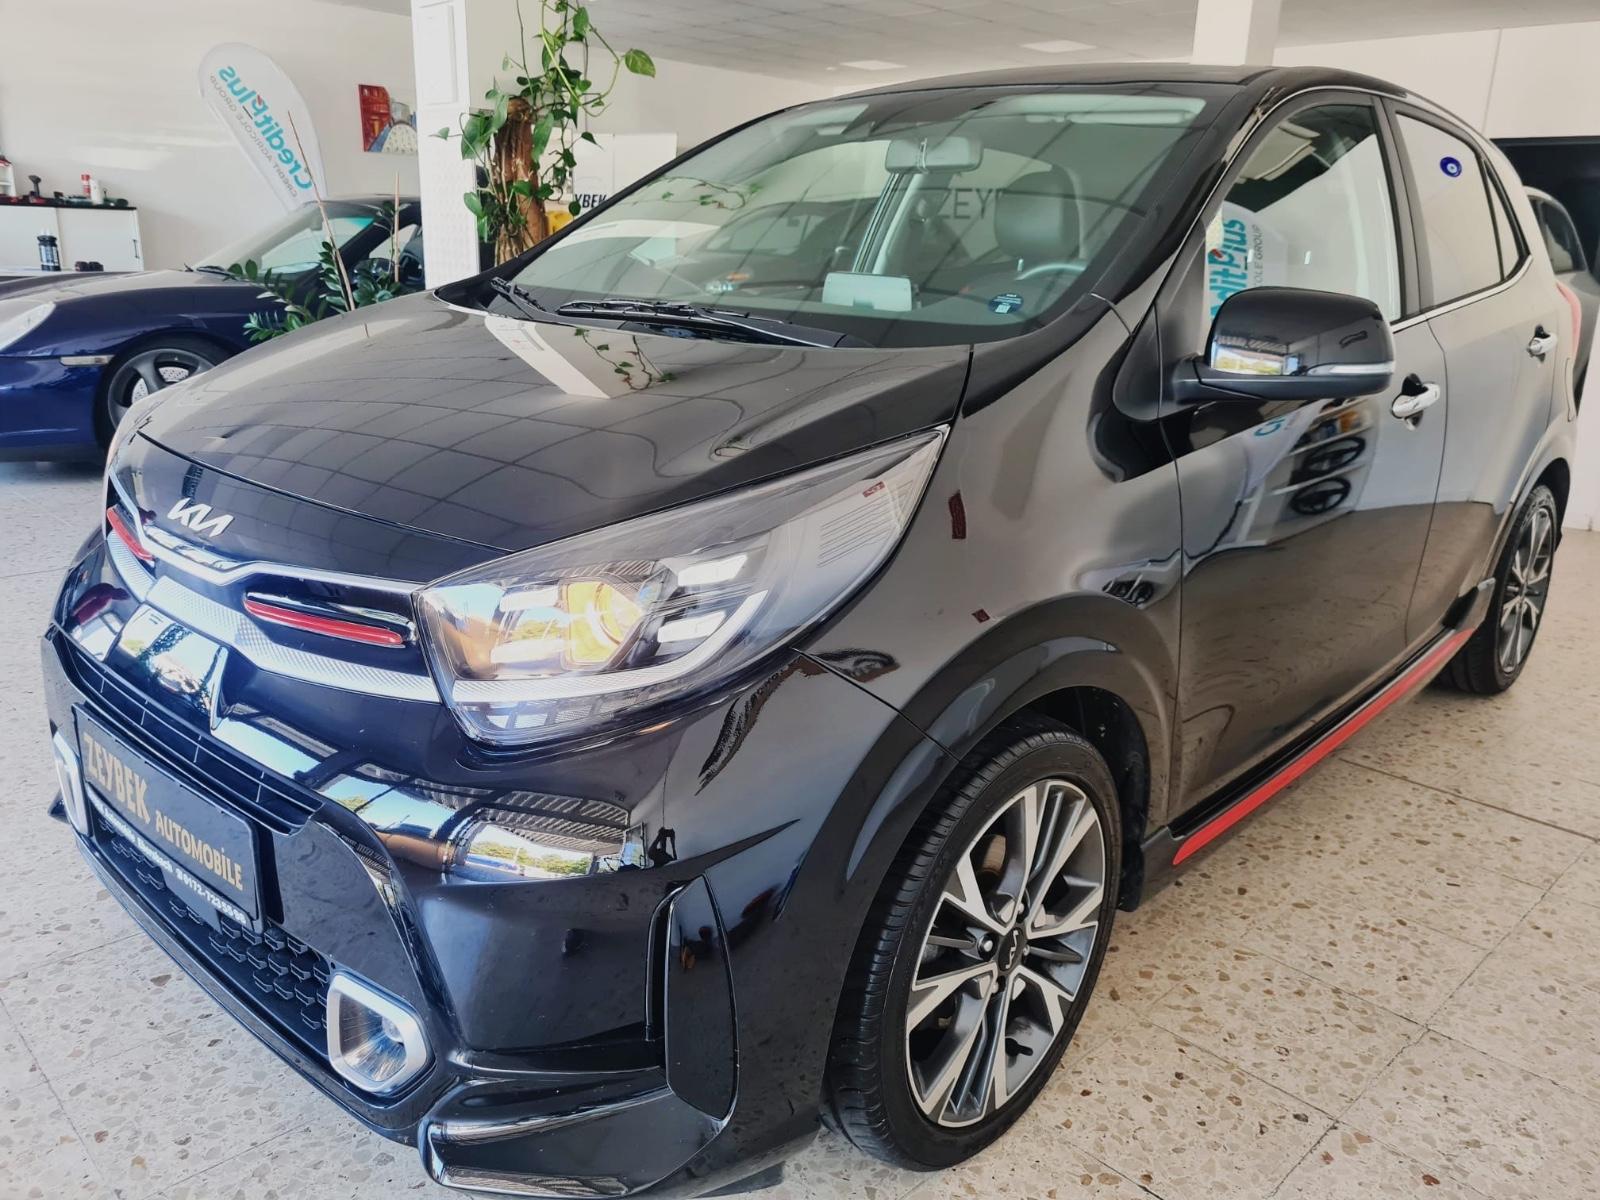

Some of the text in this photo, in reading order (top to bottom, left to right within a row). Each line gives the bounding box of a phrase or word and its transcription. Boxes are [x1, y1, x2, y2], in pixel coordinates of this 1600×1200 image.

[936, 187, 1006, 219] ZEY
[167, 497, 234, 538] KIA
[83, 733, 151, 825] ZEYBEK
